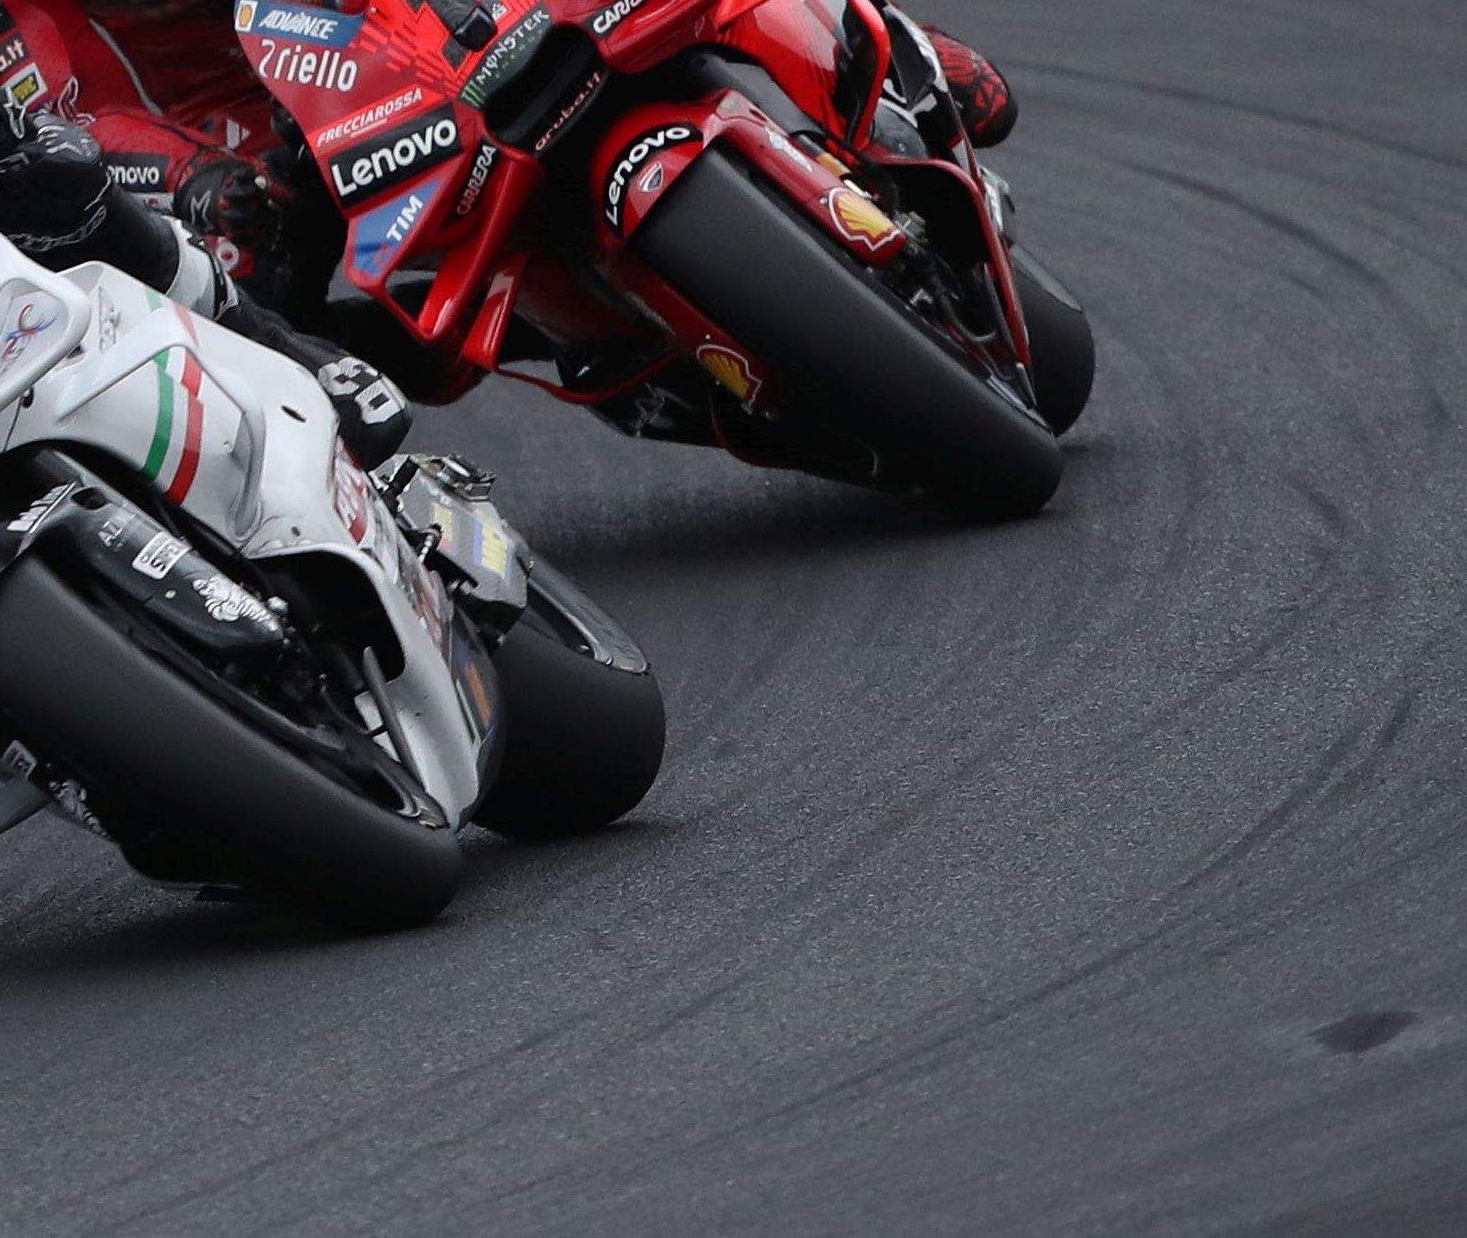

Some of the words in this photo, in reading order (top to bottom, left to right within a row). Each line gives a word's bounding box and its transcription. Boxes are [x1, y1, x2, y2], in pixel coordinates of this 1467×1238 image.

[257, 8, 339, 42] ADVANCE
[474, 9, 551, 87] MONSTER
[273, 46, 359, 93] riello
[316, 87, 423, 148] FRECCIAROSSA
[534, 71, 603, 153] aruba.it
[331, 118, 457, 197] Lenovo
[455, 144, 498, 217] CARRERA
[603, 125, 693, 223] Lenovo
[385, 193, 425, 244] TIM
